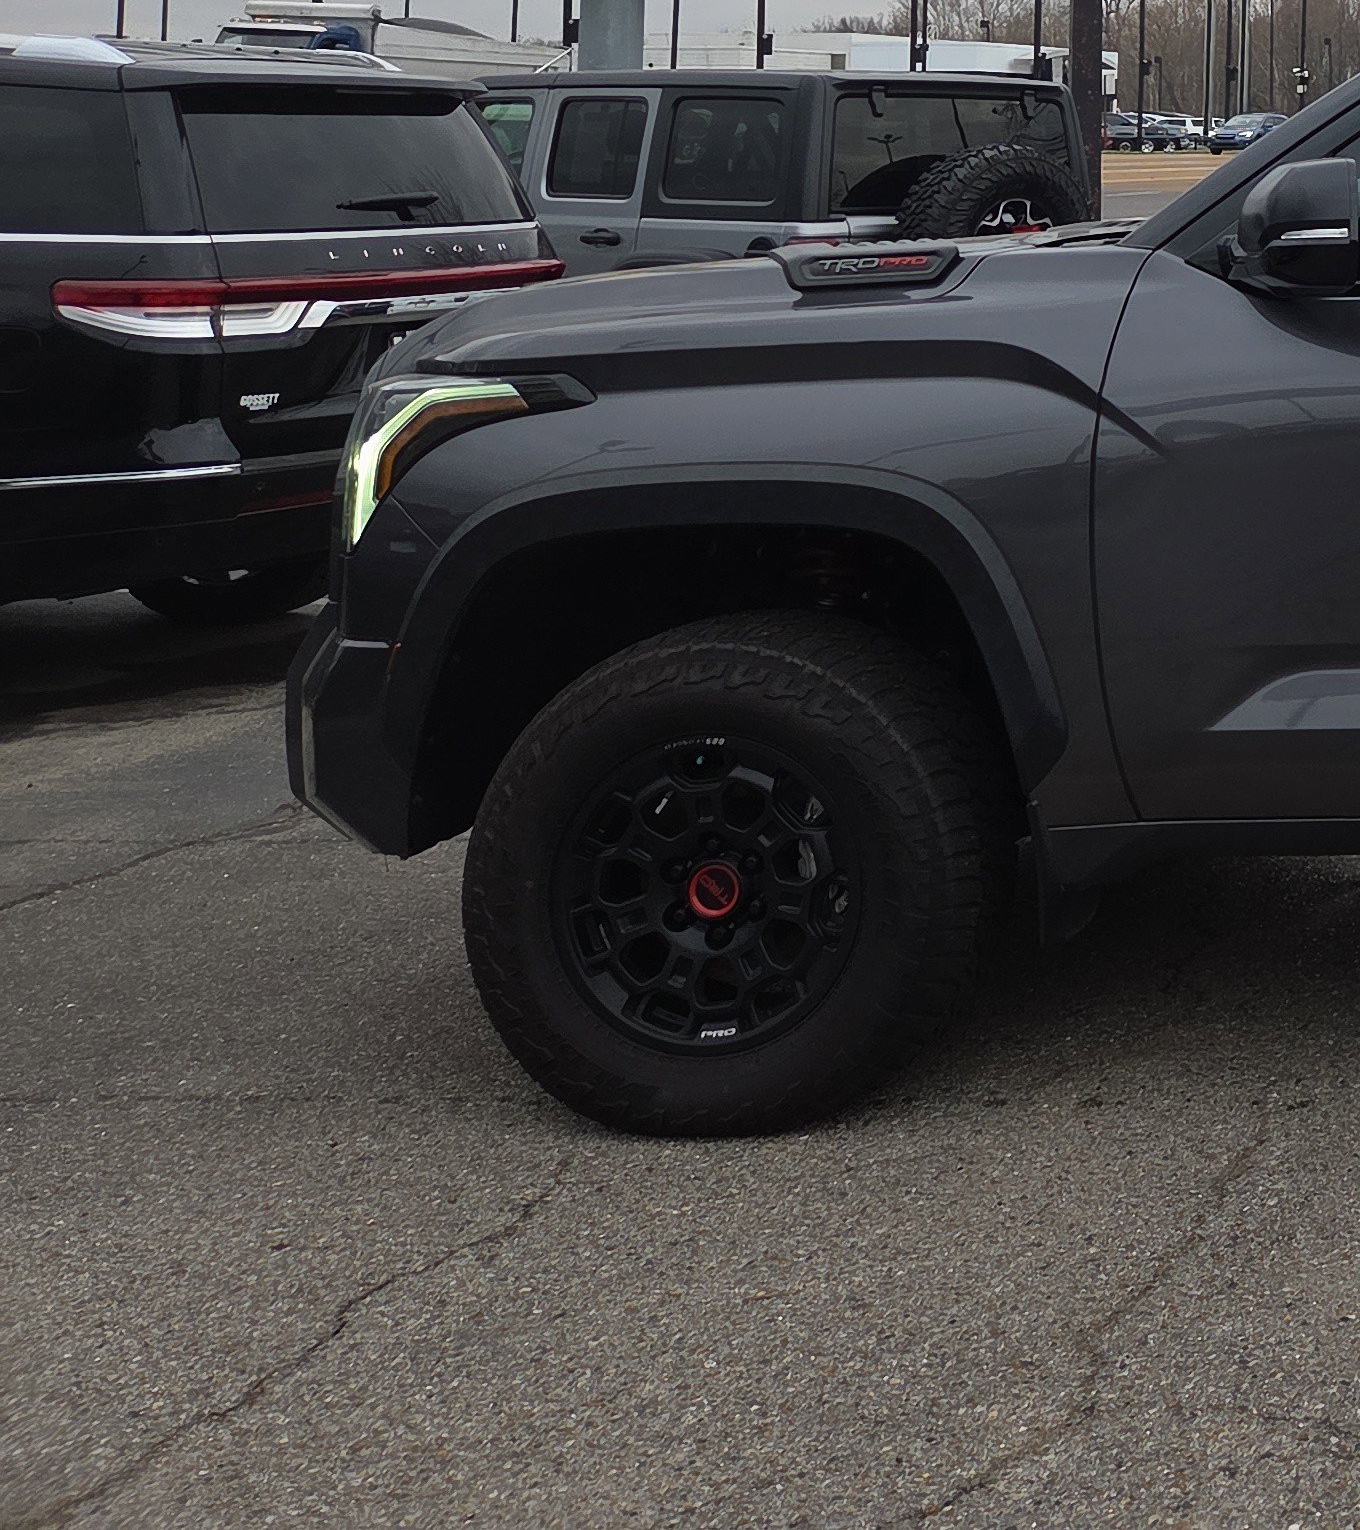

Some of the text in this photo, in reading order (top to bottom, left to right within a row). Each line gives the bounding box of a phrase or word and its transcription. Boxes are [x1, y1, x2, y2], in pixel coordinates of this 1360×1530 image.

[328, 243, 507, 260] LINCOLN
[819, 257, 880, 273] TRD
[700, 1027, 737, 1039] PRO
